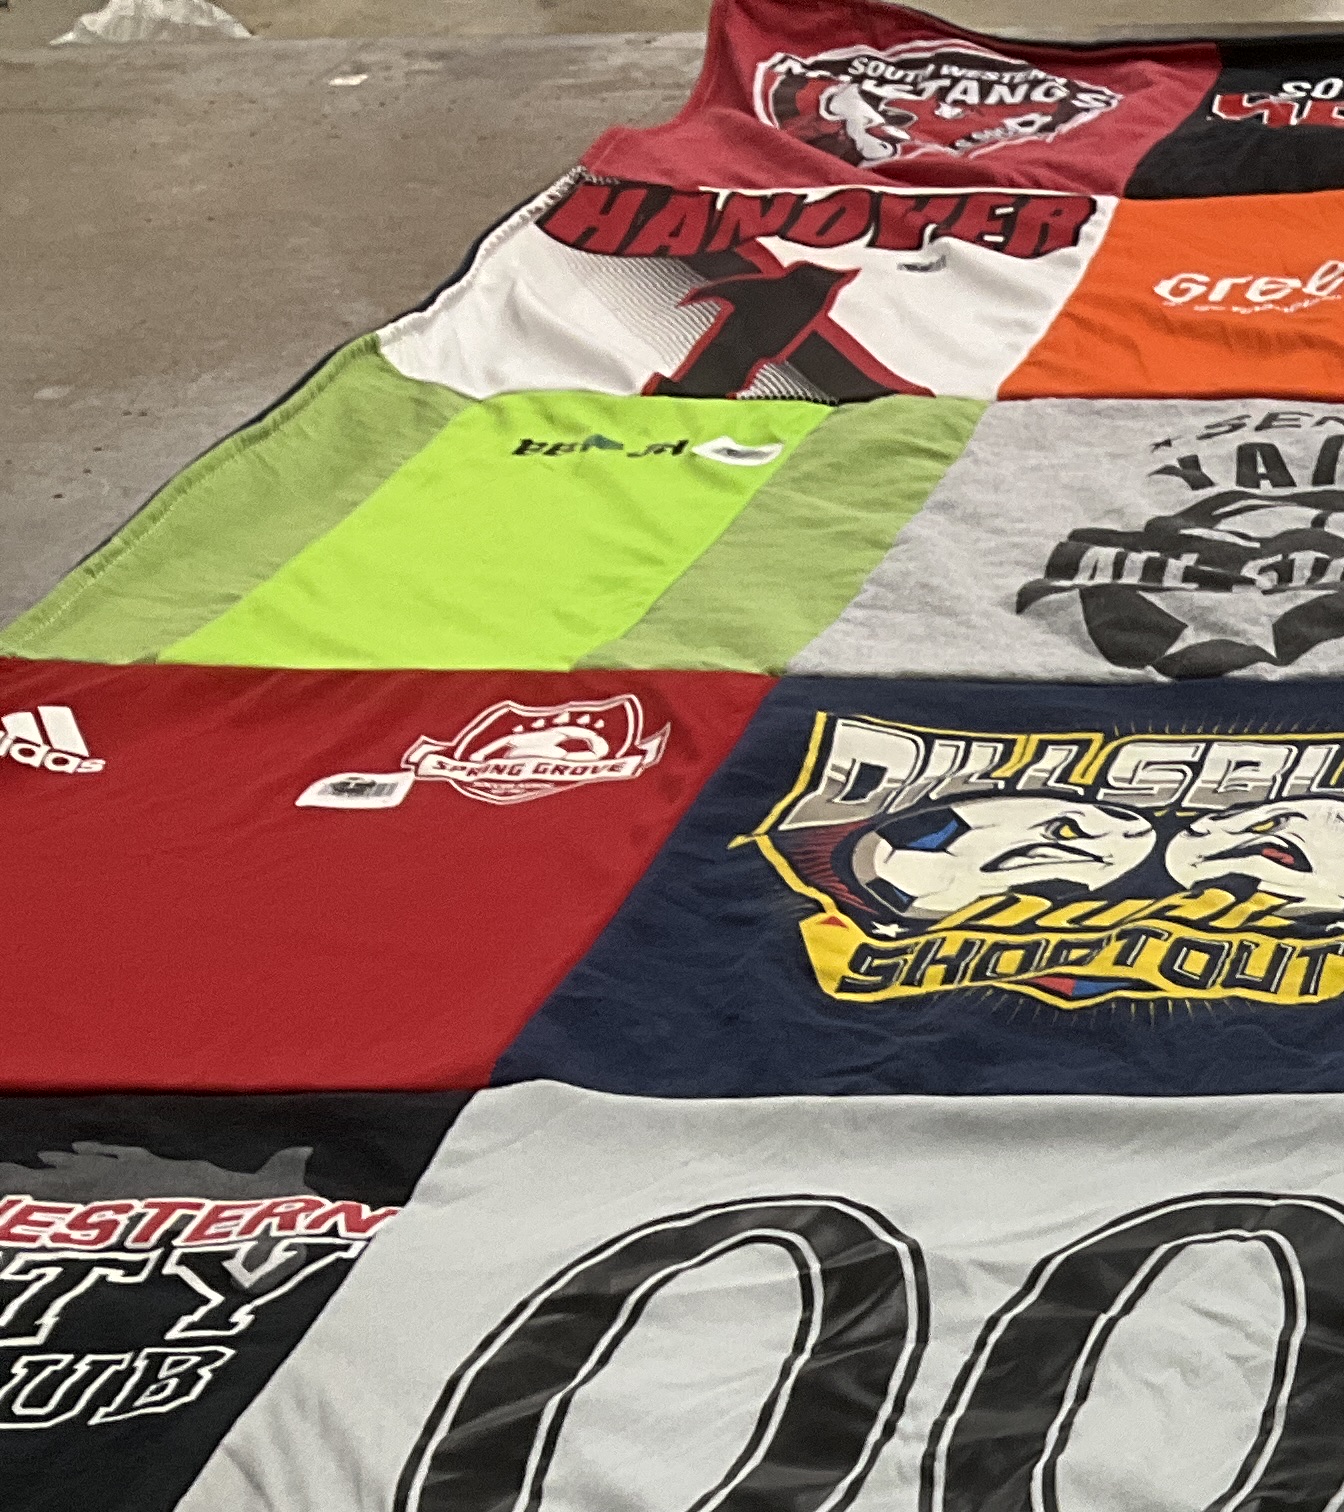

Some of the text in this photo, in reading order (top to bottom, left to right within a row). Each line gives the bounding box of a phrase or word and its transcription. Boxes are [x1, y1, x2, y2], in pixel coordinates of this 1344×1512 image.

[0, 730, 106, 774] idas
[431, 759, 628, 778] SPRING GROVE
[0, 1194, 403, 1250] ESTERN
